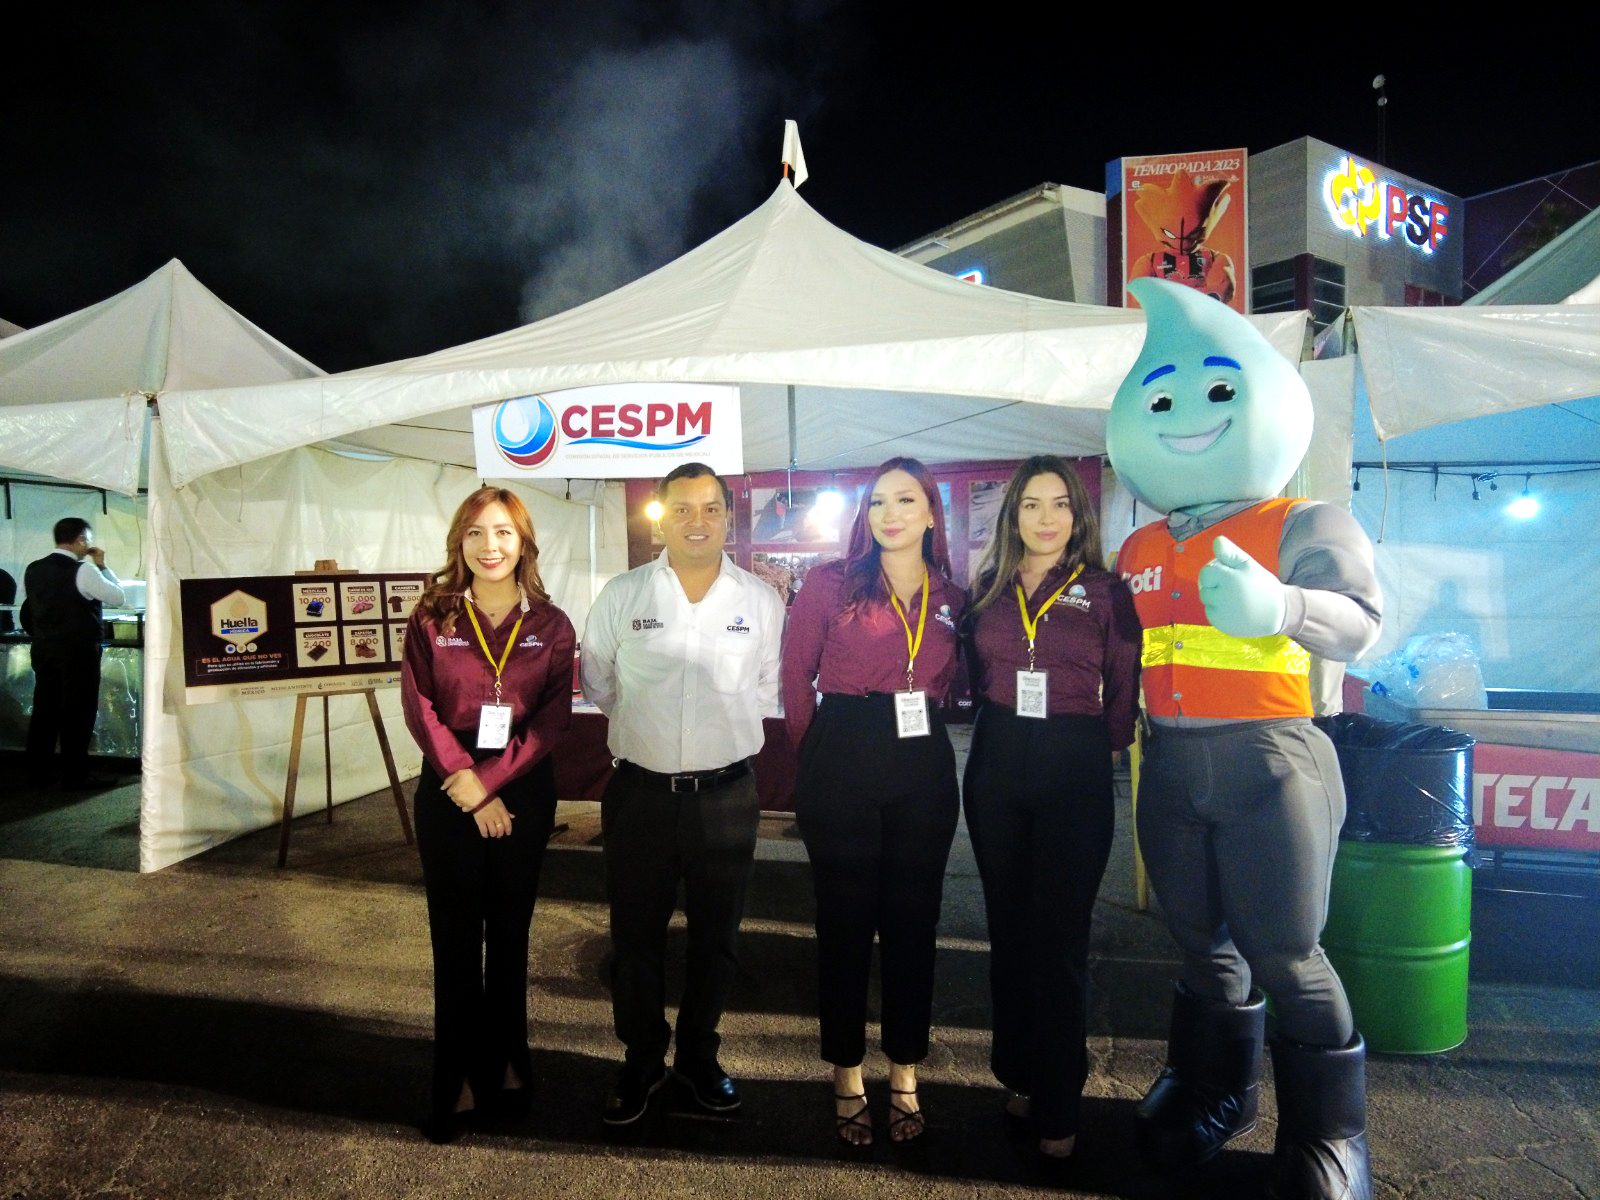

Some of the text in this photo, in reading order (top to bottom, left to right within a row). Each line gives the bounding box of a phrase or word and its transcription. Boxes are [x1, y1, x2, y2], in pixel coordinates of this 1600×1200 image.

[1133, 158, 1241, 177] TEMPORADA 2023
[1385, 184, 1449, 250] PSF
[560, 401, 712, 439] CESPM
[299, 596, 331, 605] 10000
[1057, 595, 1091, 608] CESPM
[220, 617, 258, 628] Huella
[303, 640, 331, 649] 2,400
[1472, 772, 1600, 833] TECA
